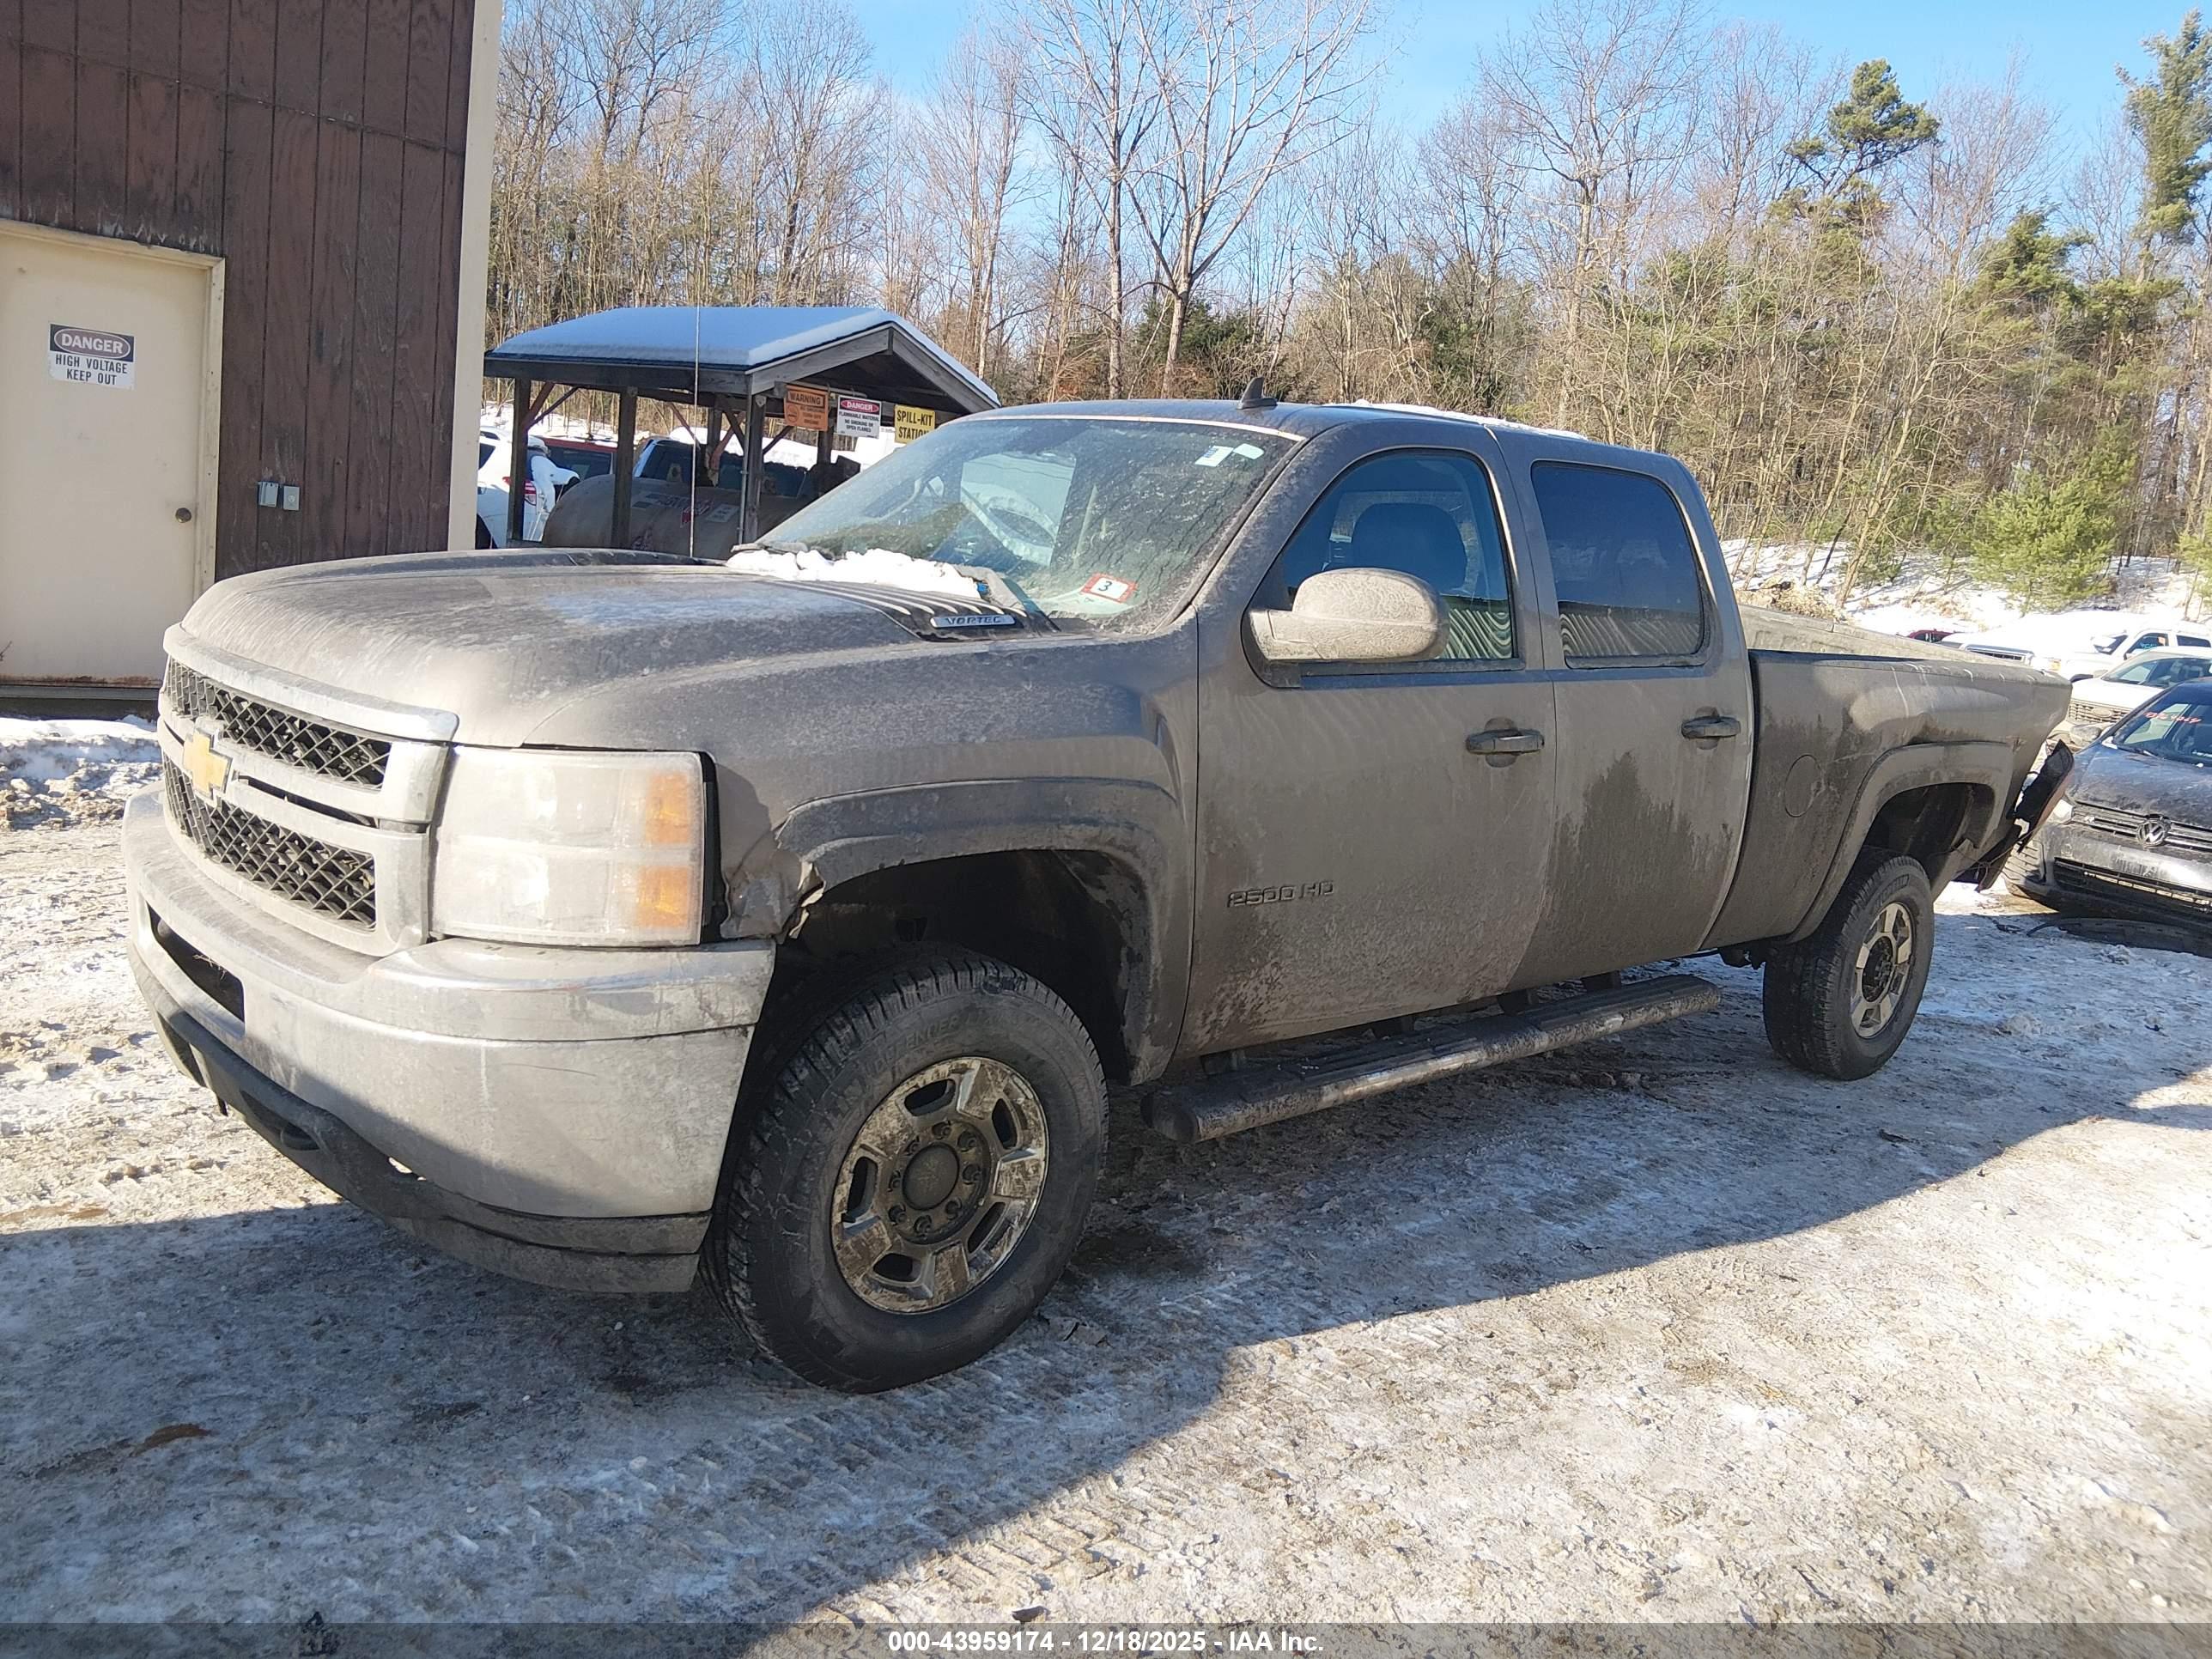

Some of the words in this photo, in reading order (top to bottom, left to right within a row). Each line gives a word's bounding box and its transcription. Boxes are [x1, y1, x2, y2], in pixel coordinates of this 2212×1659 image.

[62, 333, 123, 354] DANGER
[55, 354, 80, 368] HIGH
[87, 358, 127, 374] VOLTAGE
[67, 369, 92, 381] KEEP
[98, 373, 117, 385] OUT
[788, 391, 821, 404] WARNING
[847, 401, 873, 412] DANGER
[897, 410, 933, 426] SPILL-KIT
[1098, 580, 1113, 592] 3
[946, 616, 1001, 625] VORTEC
[1227, 884, 1296, 908] 2500
[1298, 880, 1334, 899] HD
